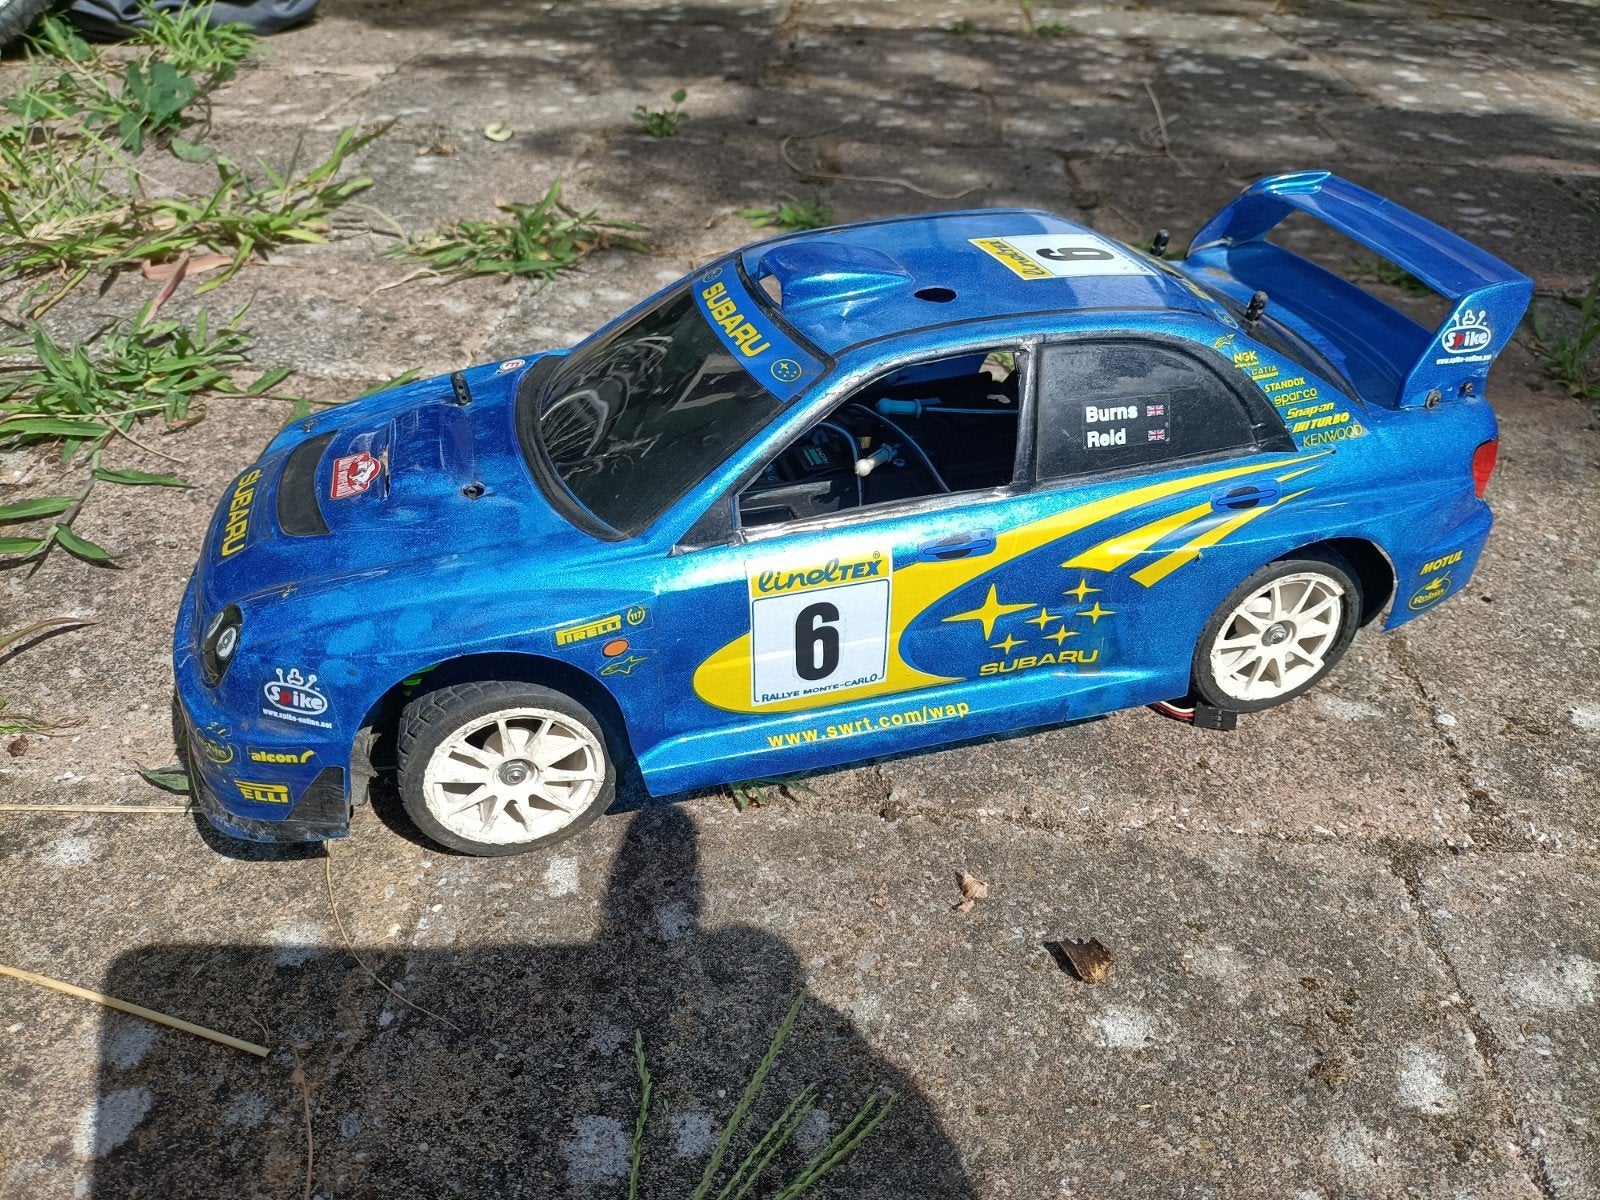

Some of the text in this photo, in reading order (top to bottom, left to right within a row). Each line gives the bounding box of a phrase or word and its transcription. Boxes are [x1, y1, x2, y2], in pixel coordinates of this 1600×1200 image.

[702, 281, 771, 357] SUBARU
[1445, 331, 1489, 350] Spike
[1234, 350, 1258, 363] NGK
[1264, 377, 1306, 393] STANDOX
[1274, 388, 1317, 406] sparco
[1085, 405, 1139, 423] Burns
[1286, 402, 1335, 419] Snap-on
[1310, 412, 1350, 429] TURBO
[1303, 424, 1363, 447] KENWOOD
[222, 469, 263, 556] SUBARU
[1419, 549, 1464, 576] MOTUL
[555, 614, 622, 646] PIRELLI
[795, 601, 840, 681] 6
[979, 649, 1099, 676] SUBARU
[268, 685, 323, 710] Spike
[761, 673, 878, 703] RALLYE MONTE-CARLO
[767, 701, 970, 748] www.swrt.com/wap
[251, 751, 299, 764] alcon
